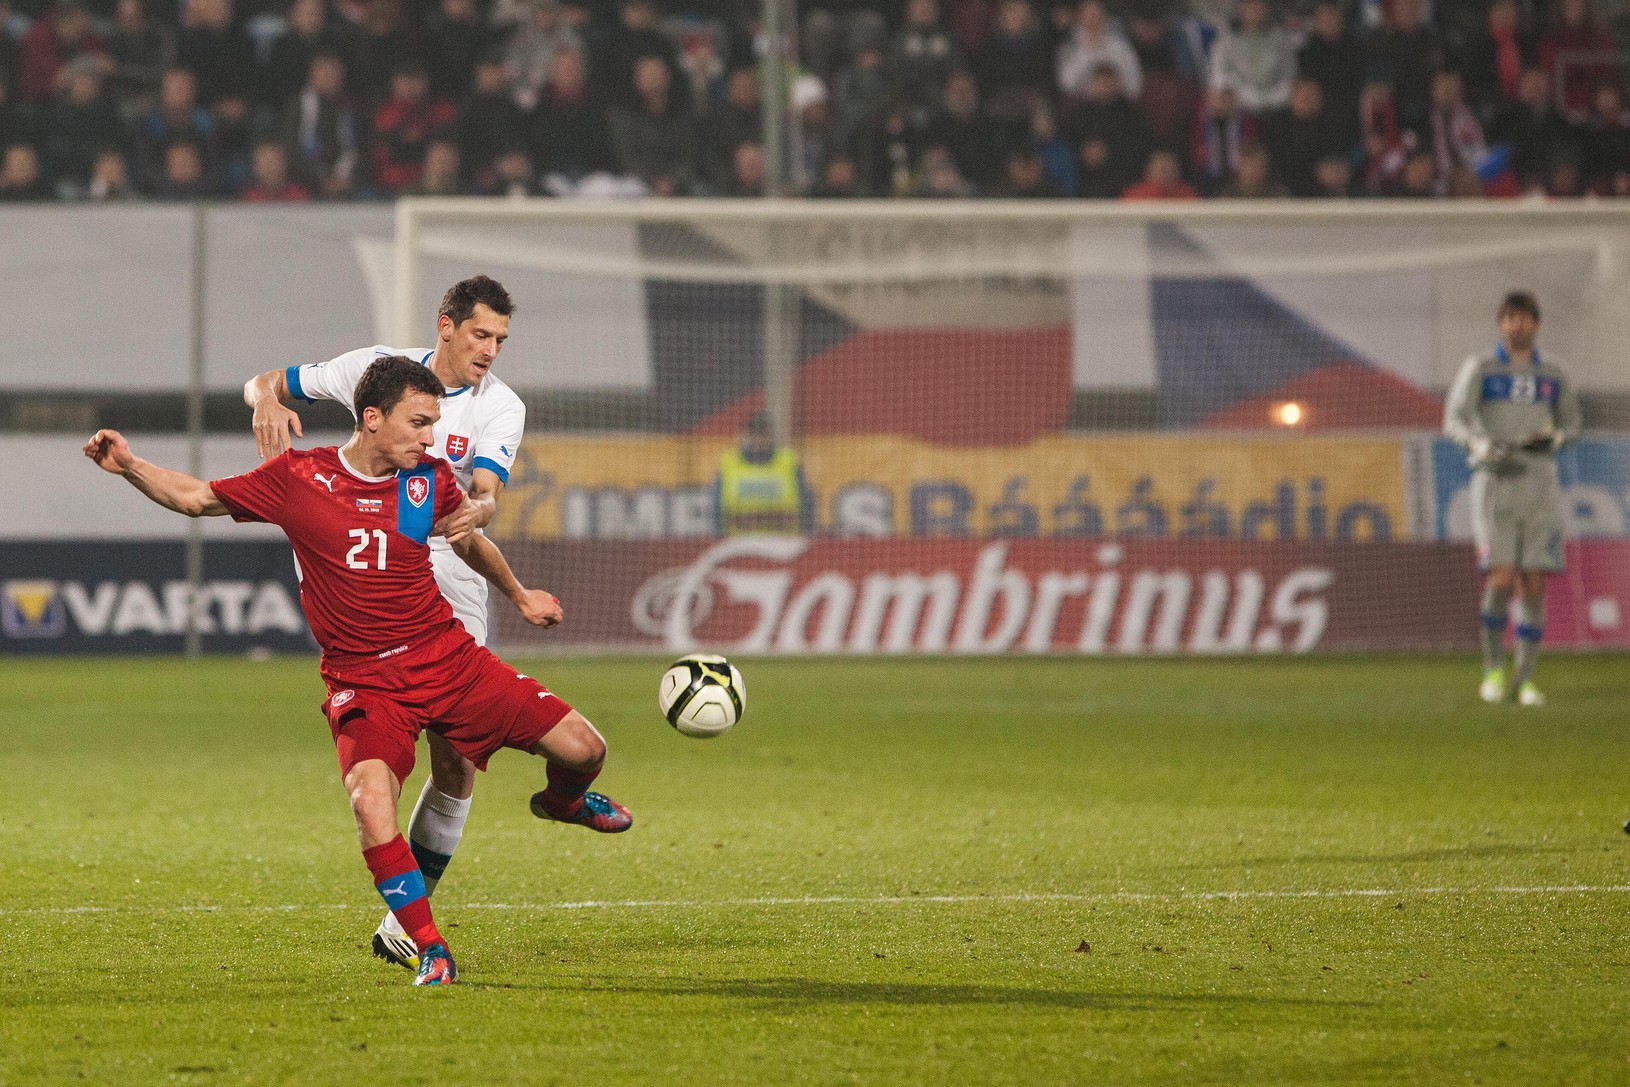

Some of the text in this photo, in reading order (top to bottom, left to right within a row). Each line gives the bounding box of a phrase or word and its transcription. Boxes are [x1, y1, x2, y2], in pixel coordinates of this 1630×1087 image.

[565, 484, 893, 538] IMPS
[346, 528, 387, 570] 21
[63, 581, 302, 634] VARTA
[632, 536, 1333, 653] Gambrinus
